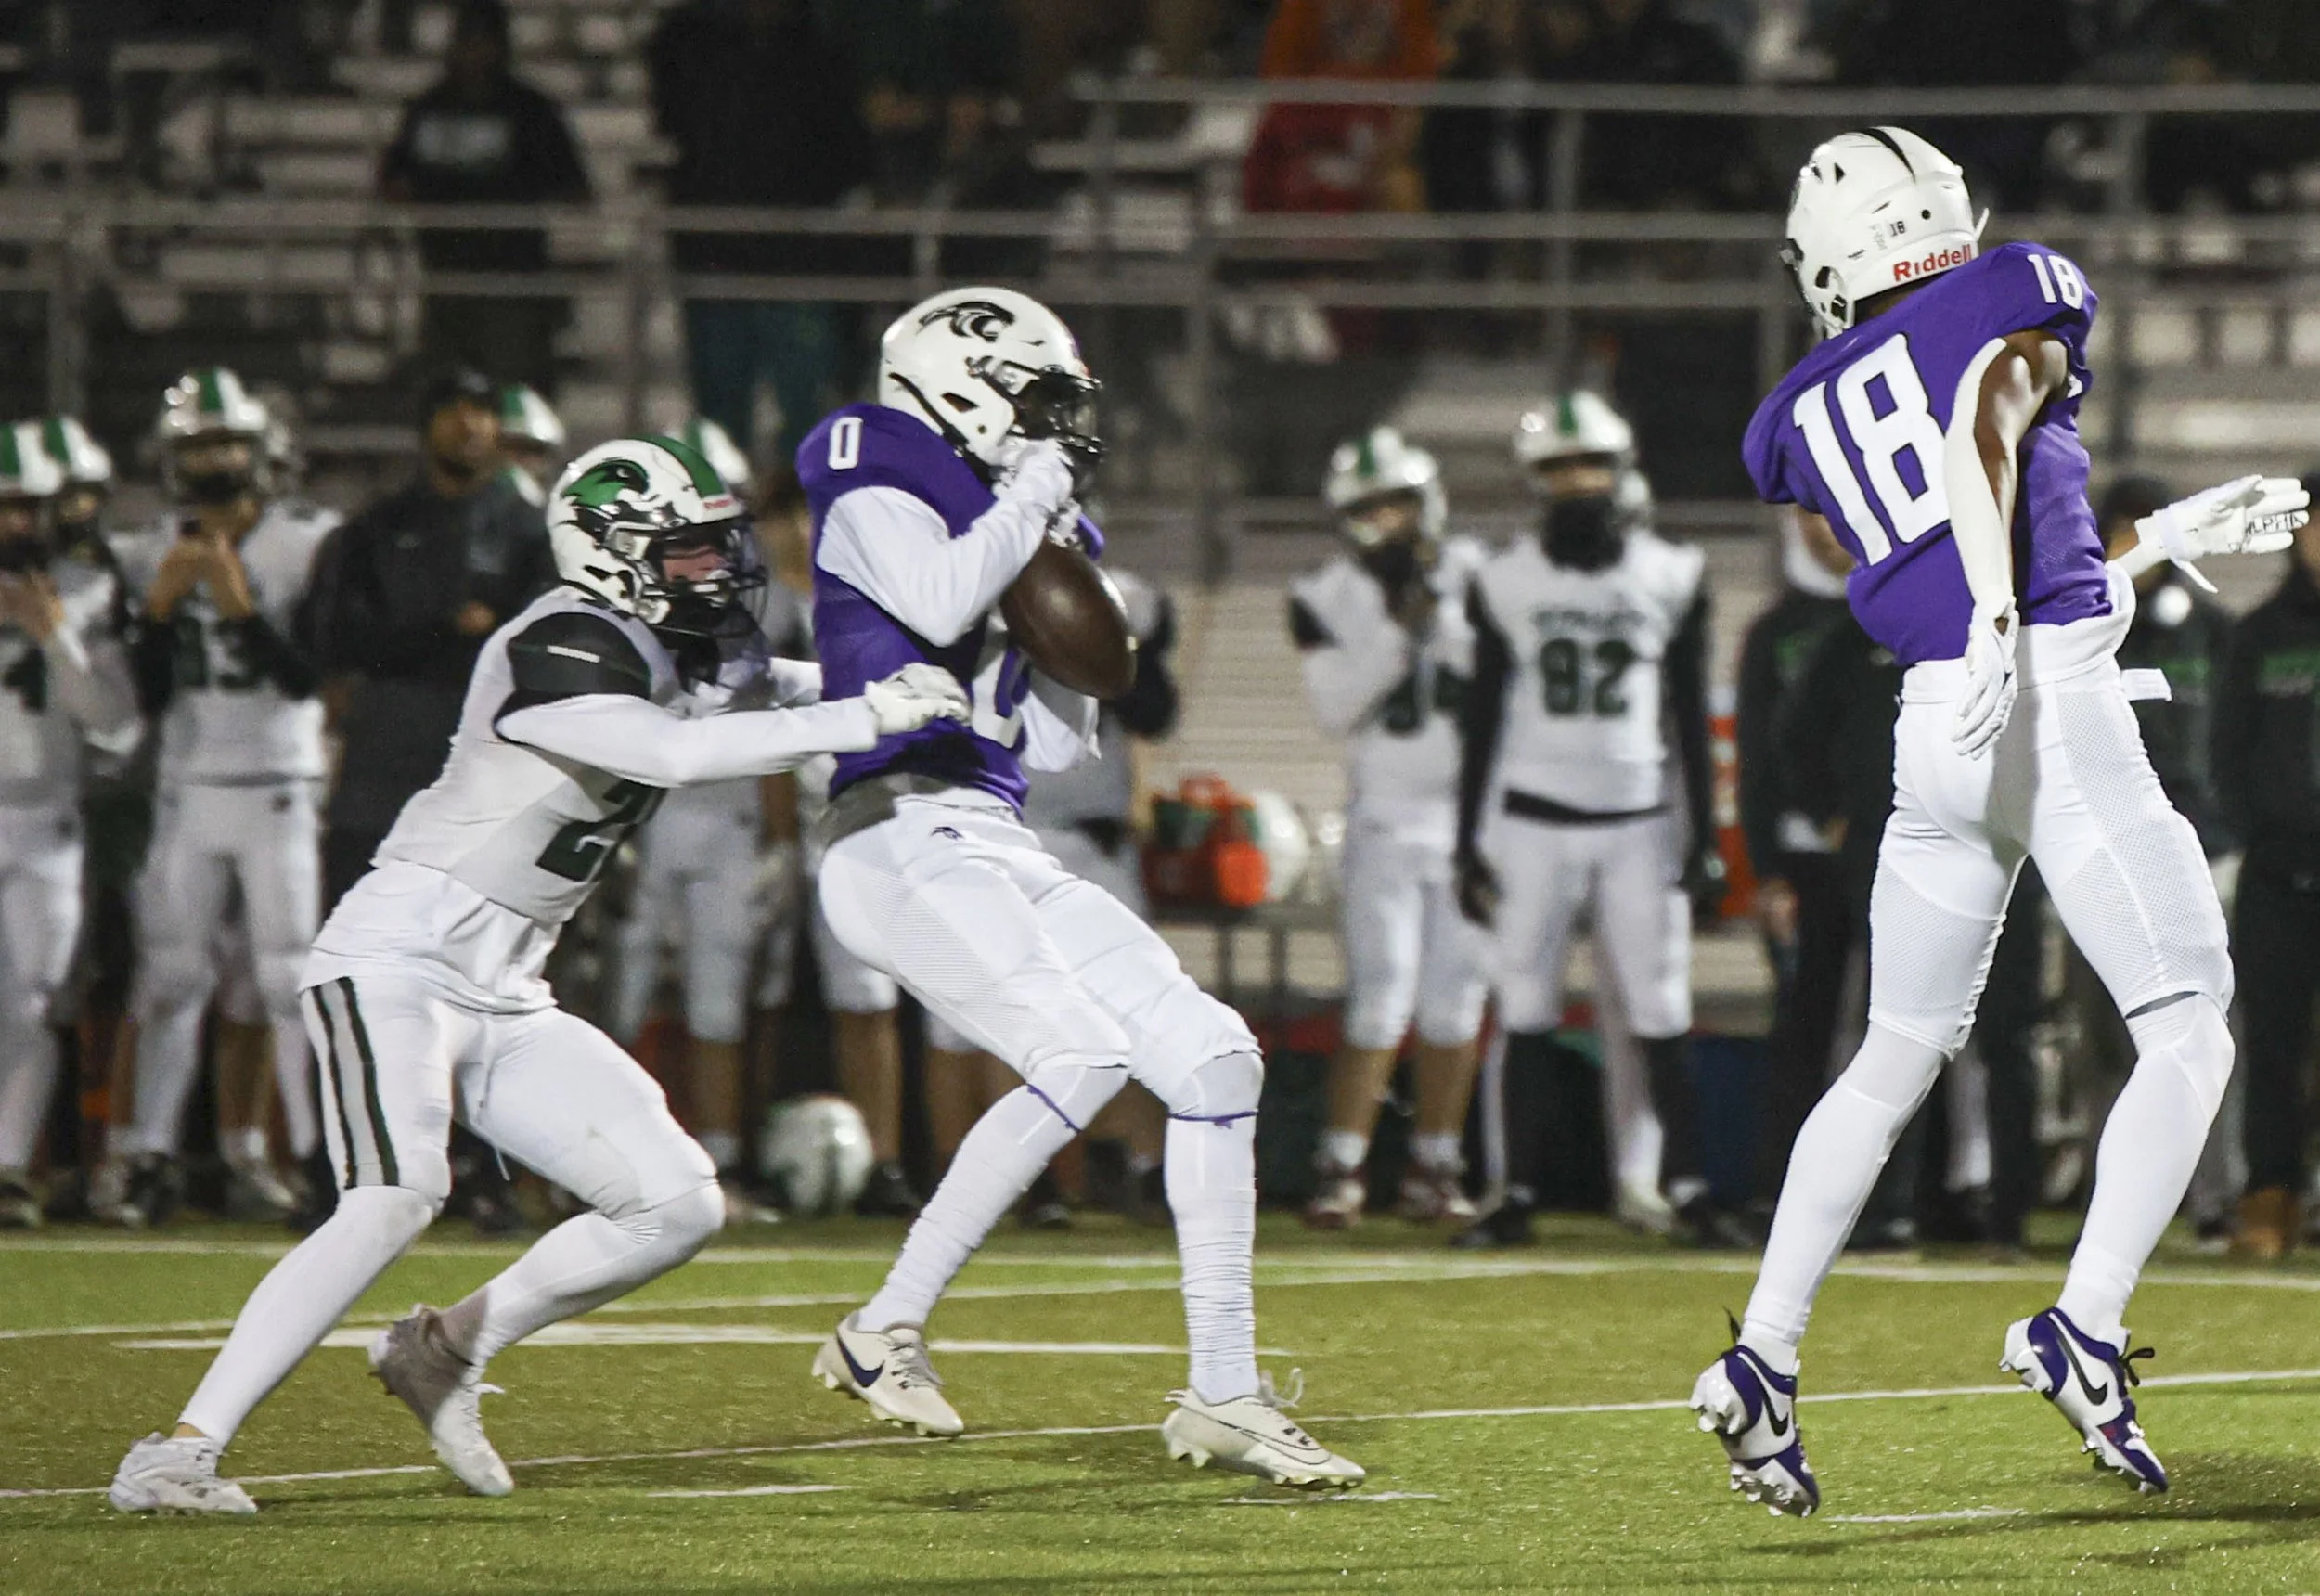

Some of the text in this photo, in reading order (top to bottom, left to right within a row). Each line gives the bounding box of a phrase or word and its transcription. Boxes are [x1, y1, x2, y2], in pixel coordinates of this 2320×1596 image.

[1889, 220, 1906, 237] 18
[1892, 243, 1973, 282] Riddell
[2026, 253, 2083, 310] 18
[828, 417, 863, 470] 0
[1792, 332, 1952, 567] 18
[1540, 638, 1630, 716] 82
[535, 778, 670, 882] 2
